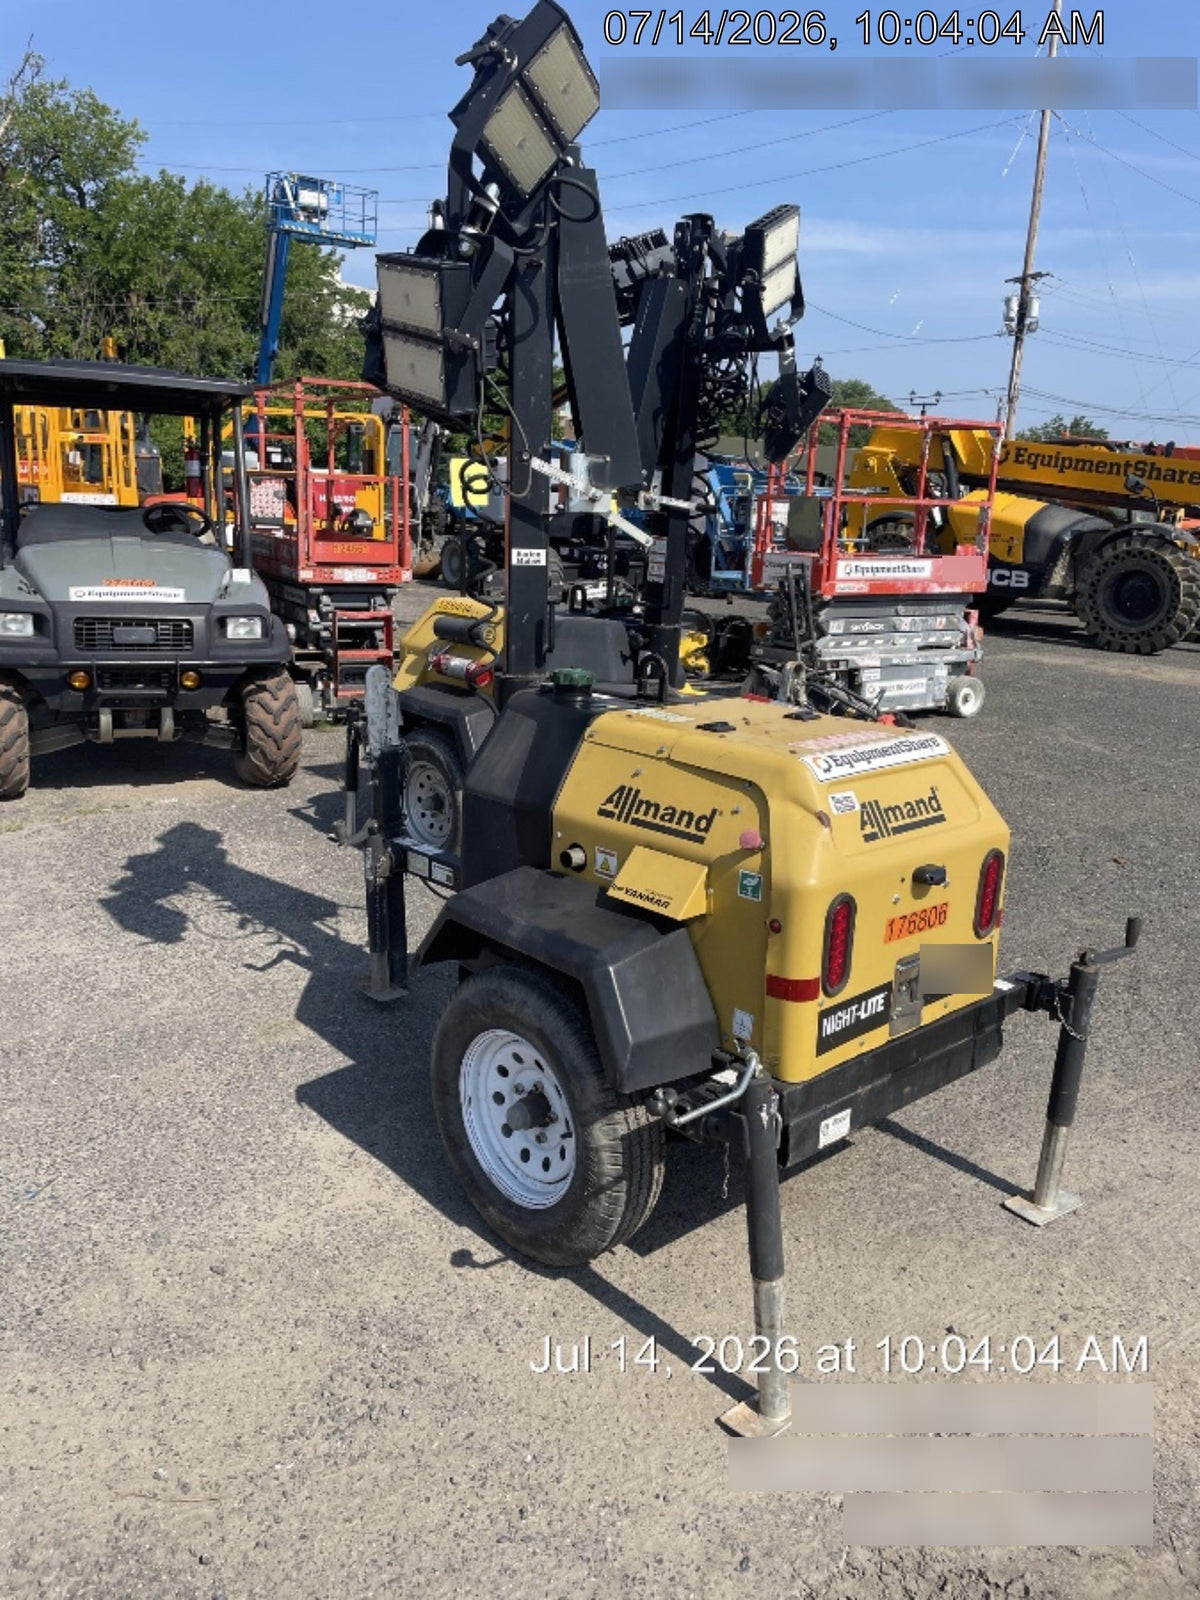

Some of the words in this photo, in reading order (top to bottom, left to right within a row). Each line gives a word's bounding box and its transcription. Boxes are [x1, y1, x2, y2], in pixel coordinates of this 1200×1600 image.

[1012, 446, 1200, 484] EquipmentShare
[830, 736, 942, 769] EquipmentShare
[600, 784, 719, 835] Allmand
[860, 786, 944, 839] Allmand
[624, 886, 671, 910] YANMAR
[887, 902, 949, 942] 176806
[822, 992, 887, 1038] NIGHT-LITE
